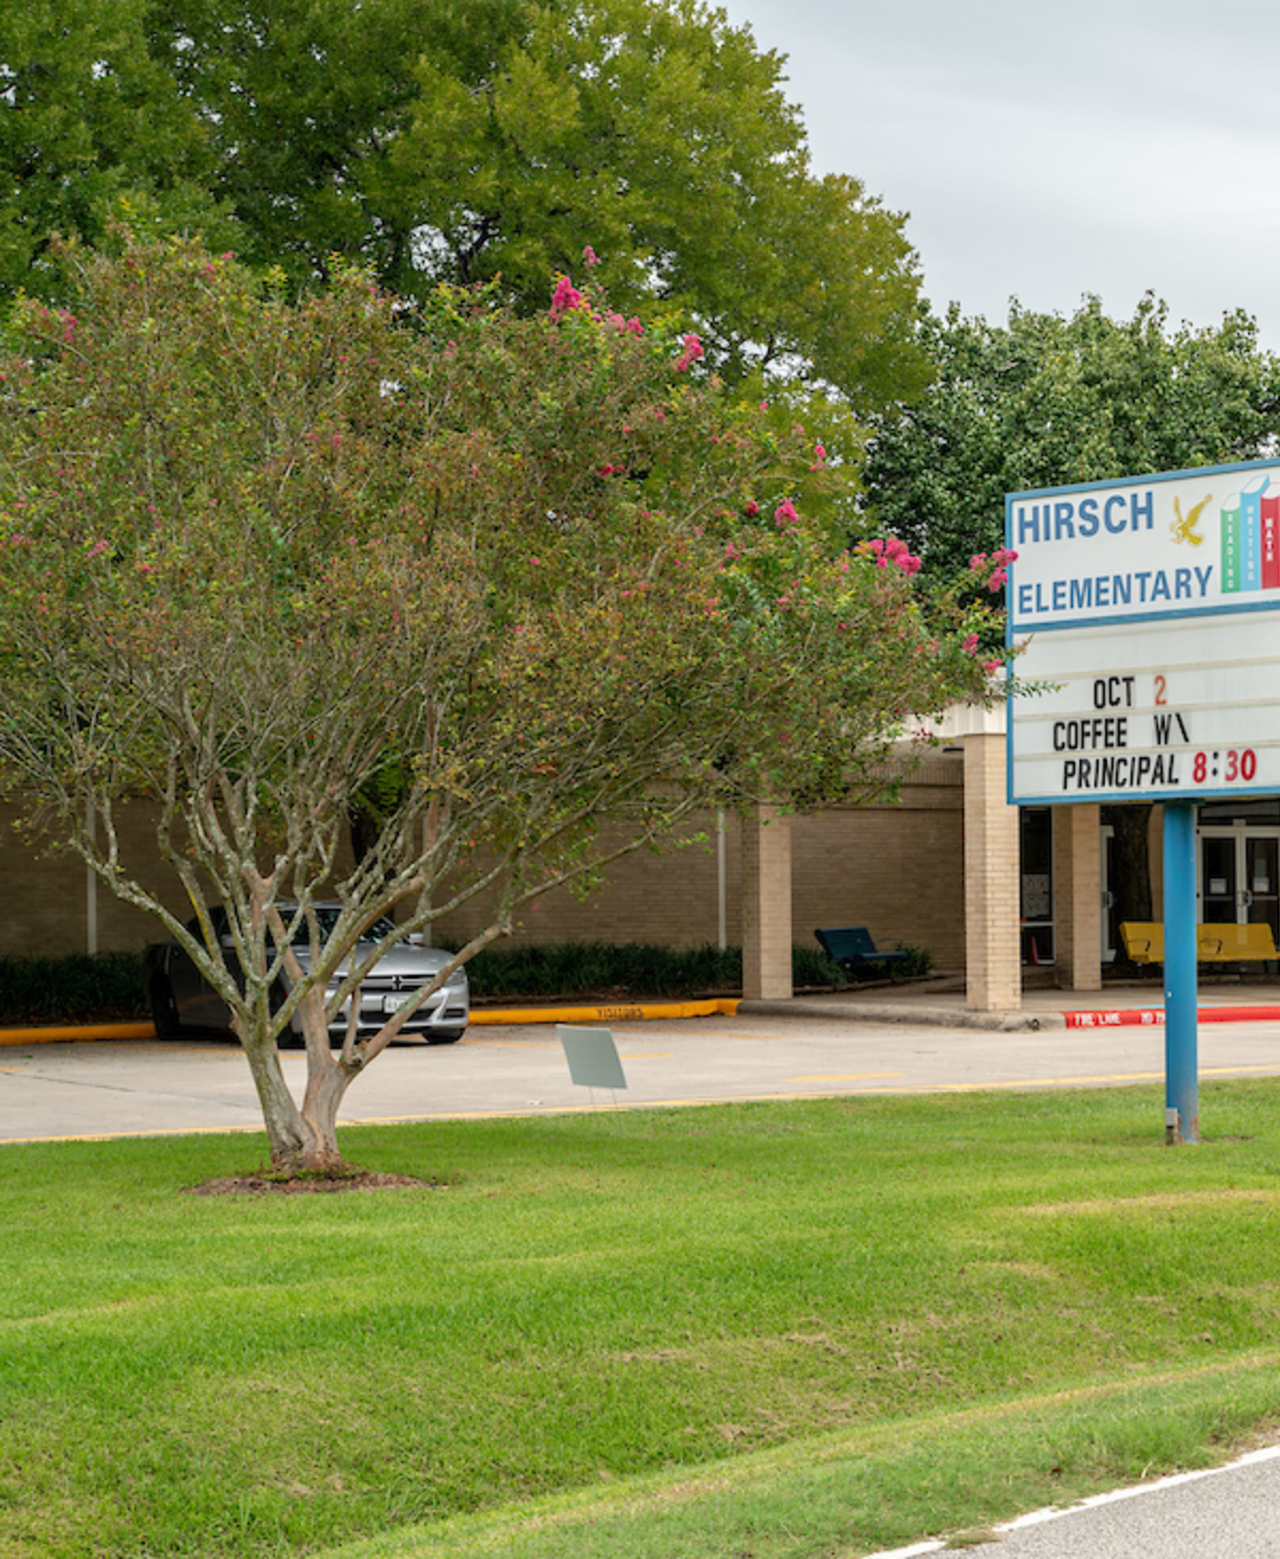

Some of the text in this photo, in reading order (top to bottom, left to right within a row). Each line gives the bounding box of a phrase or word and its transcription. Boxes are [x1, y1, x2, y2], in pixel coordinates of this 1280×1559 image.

[1018, 491, 1154, 544] HIRSCH
[1265, 518, 1274, 561] MATH
[1226, 513, 1235, 589] READING
[1247, 505, 1255, 581] WRITING
[1018, 565, 1214, 614] ELEMENTARY
[1093, 675, 1167, 709] OCT 2
[1053, 717, 1128, 751] COFFEE
[1062, 749, 1257, 790] PRINCIPAL 8:30
